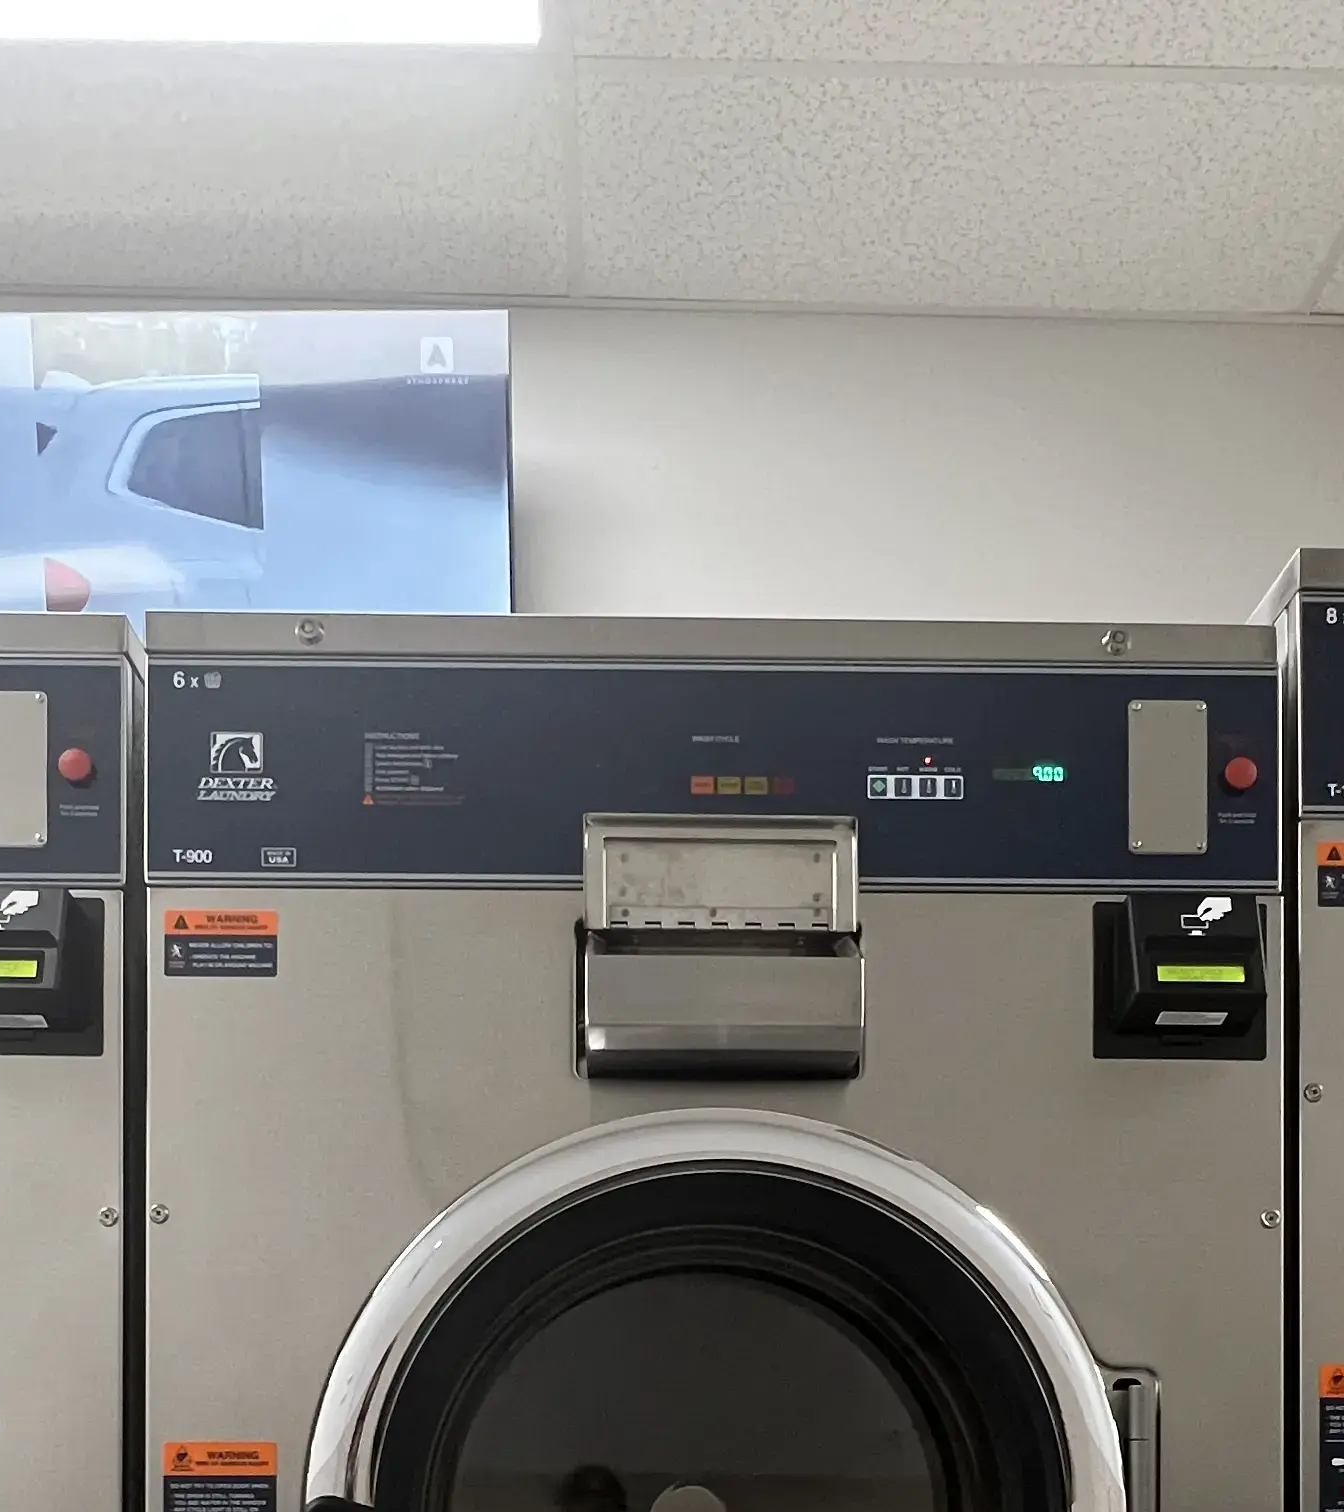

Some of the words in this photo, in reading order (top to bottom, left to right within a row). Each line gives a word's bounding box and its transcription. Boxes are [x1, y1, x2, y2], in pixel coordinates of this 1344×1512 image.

[1326, 607, 1338, 624] 8
[173, 671, 186, 688] 6
[190, 676, 199, 688] x
[198, 777, 274, 789] DEXTER
[197, 790, 276, 801] LAUNDRY
[173, 849, 213, 864] T-900
[206, 914, 258, 924] WARNING
[207, 1451, 259, 1460] WARNING
